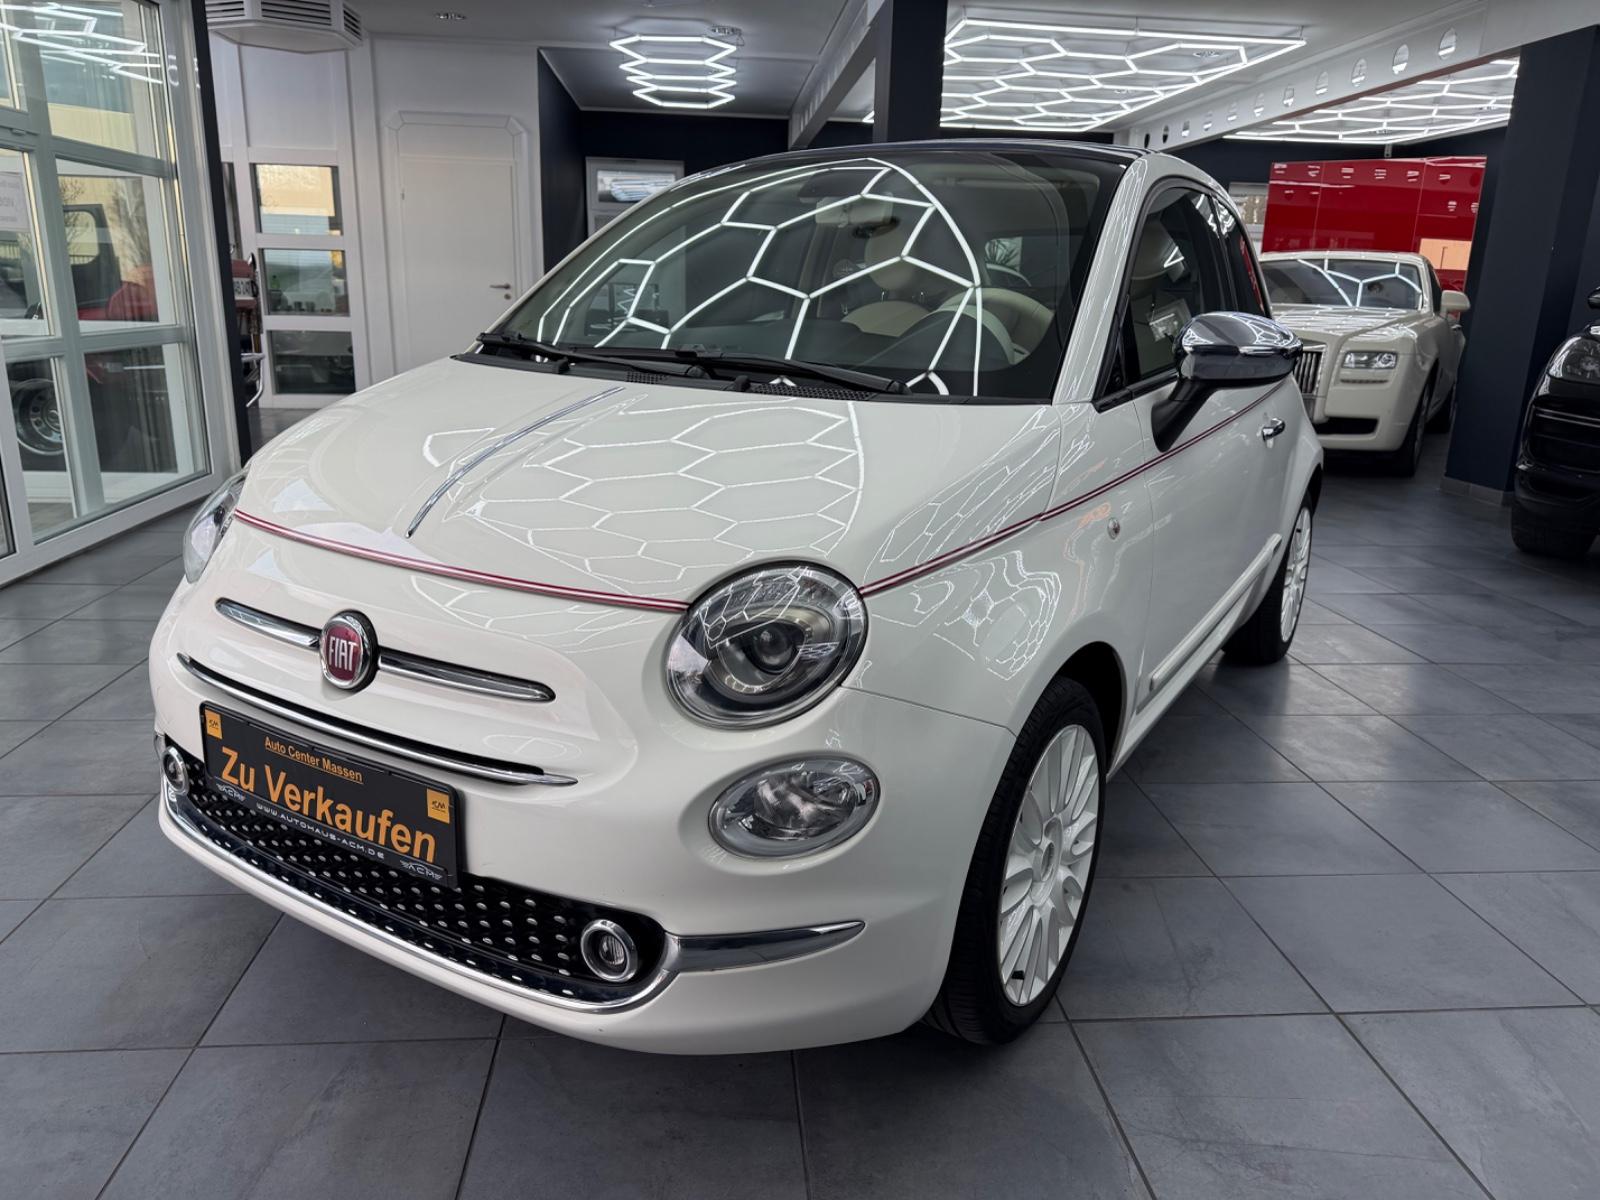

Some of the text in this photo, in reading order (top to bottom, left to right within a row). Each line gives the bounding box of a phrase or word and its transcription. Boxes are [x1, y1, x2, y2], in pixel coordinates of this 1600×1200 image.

[328, 635, 359, 671] FIAT
[264, 736, 363, 782] Auto Center Massen
[221, 745, 436, 864] Zu Verkaufen
